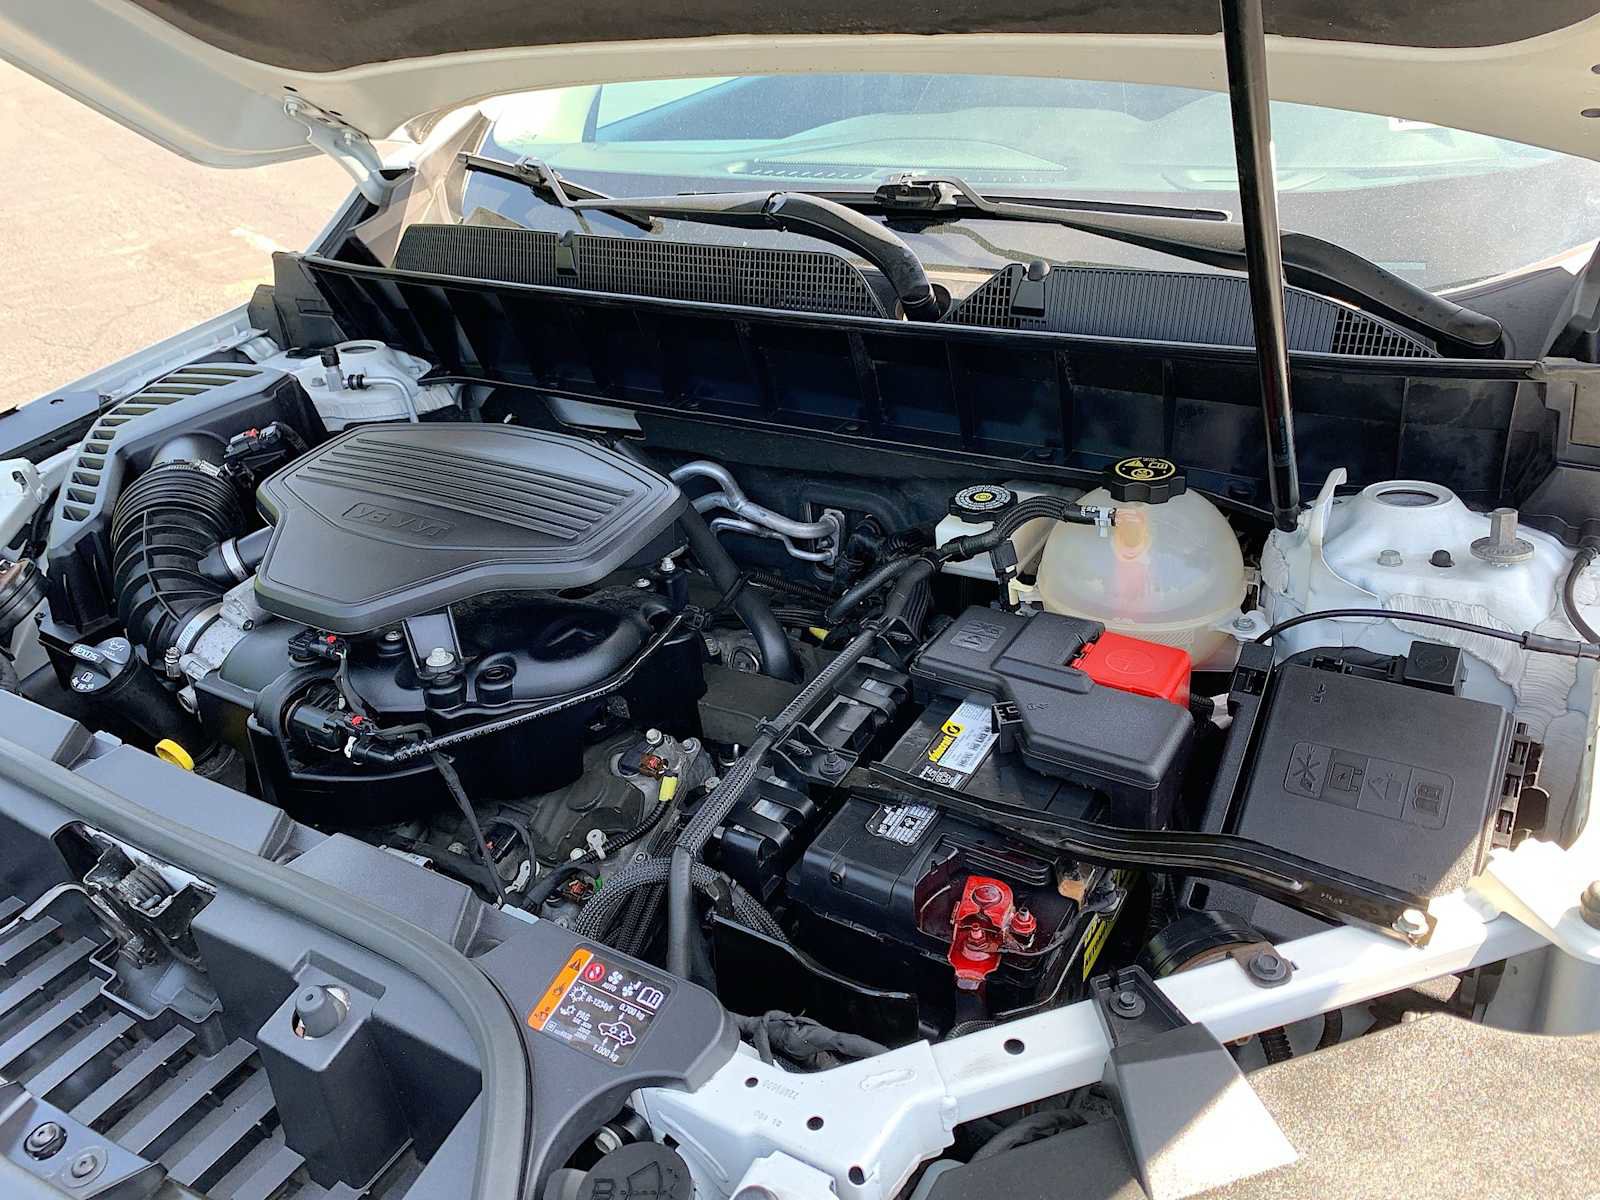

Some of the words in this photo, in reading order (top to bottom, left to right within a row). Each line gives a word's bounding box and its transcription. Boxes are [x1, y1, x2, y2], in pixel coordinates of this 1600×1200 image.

[351, 505, 393, 524] V6
[601, 982, 617, 992] AUTO
[586, 995, 615, 1012] R-1234yf
[619, 1003, 638, 1016] 0.700
[636, 1010, 646, 1022] kg
[575, 1009, 592, 1022] PAG
[592, 1043, 611, 1058] 1.000
[609, 1051, 620, 1063] kg
